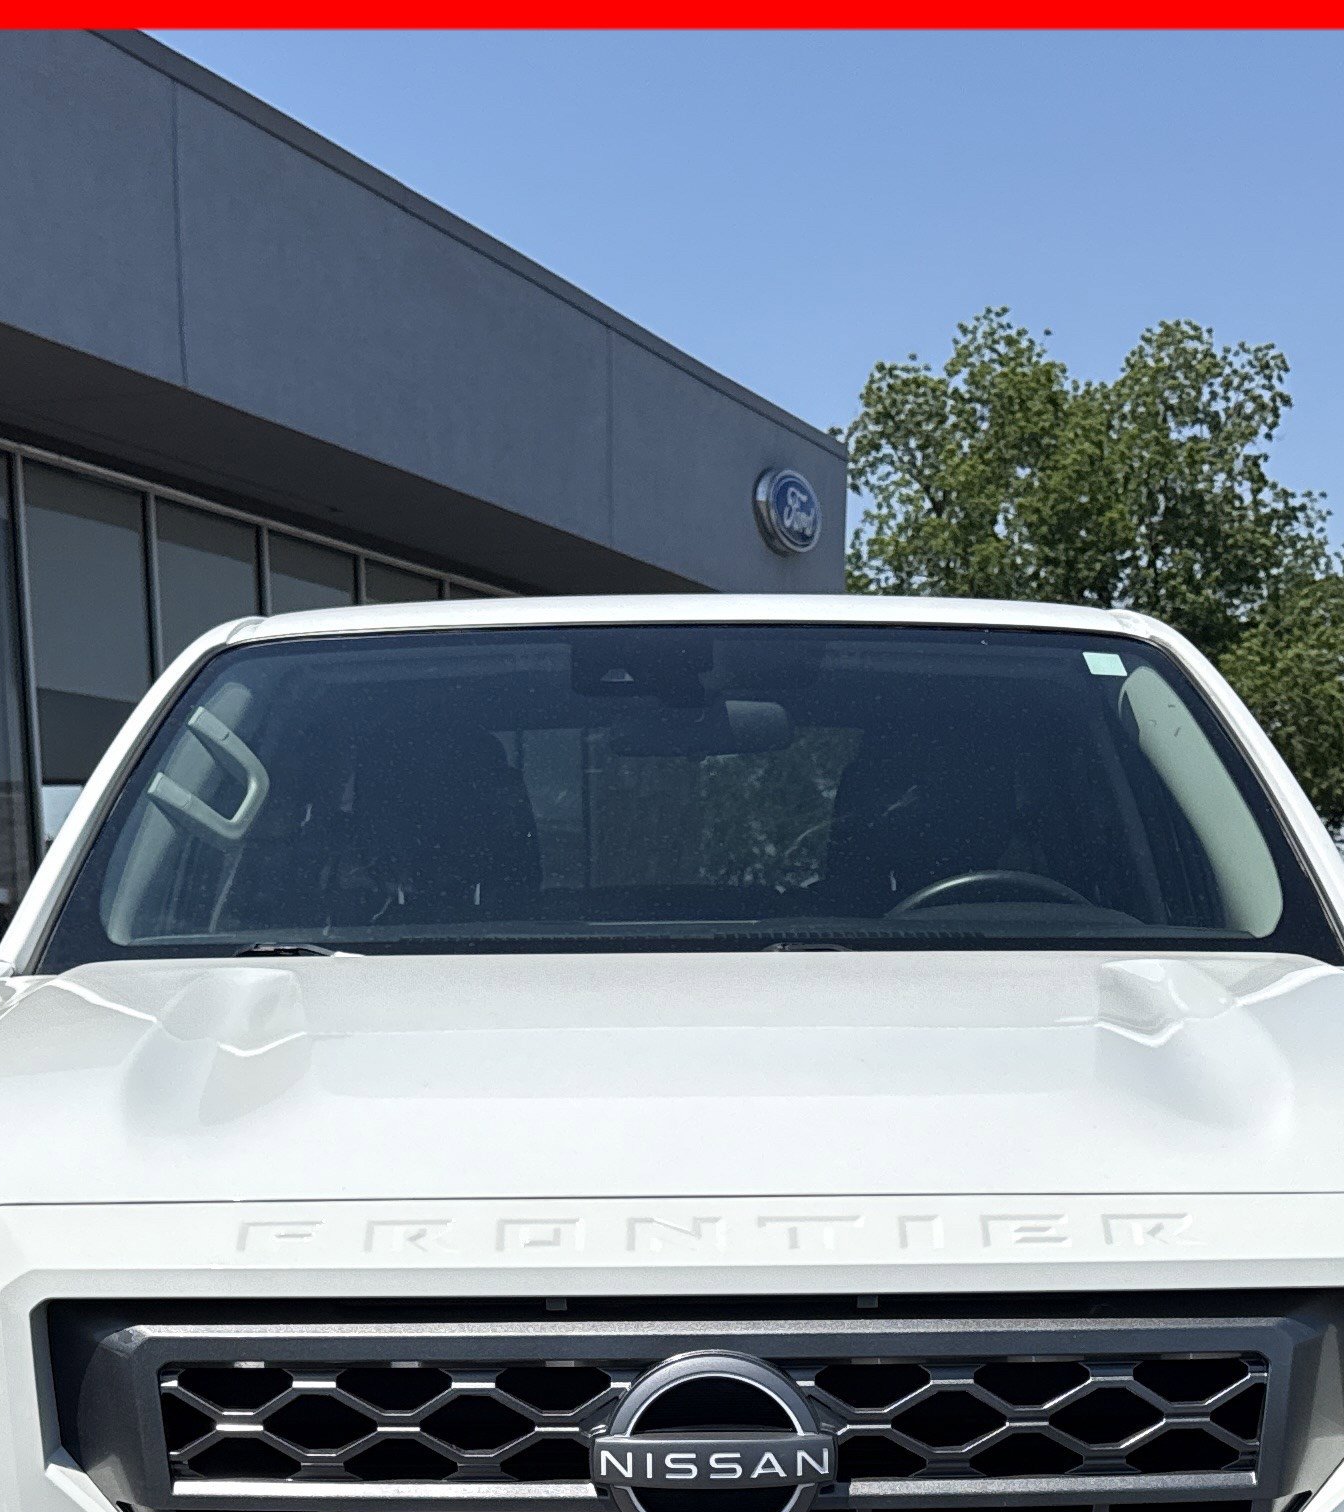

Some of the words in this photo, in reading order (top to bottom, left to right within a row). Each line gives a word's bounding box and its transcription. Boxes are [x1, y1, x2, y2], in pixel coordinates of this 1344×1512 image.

[782, 486, 815, 536] Ford
[236, 1212, 1203, 1253] FRONTIER
[597, 1446, 833, 1480] NISSAN
